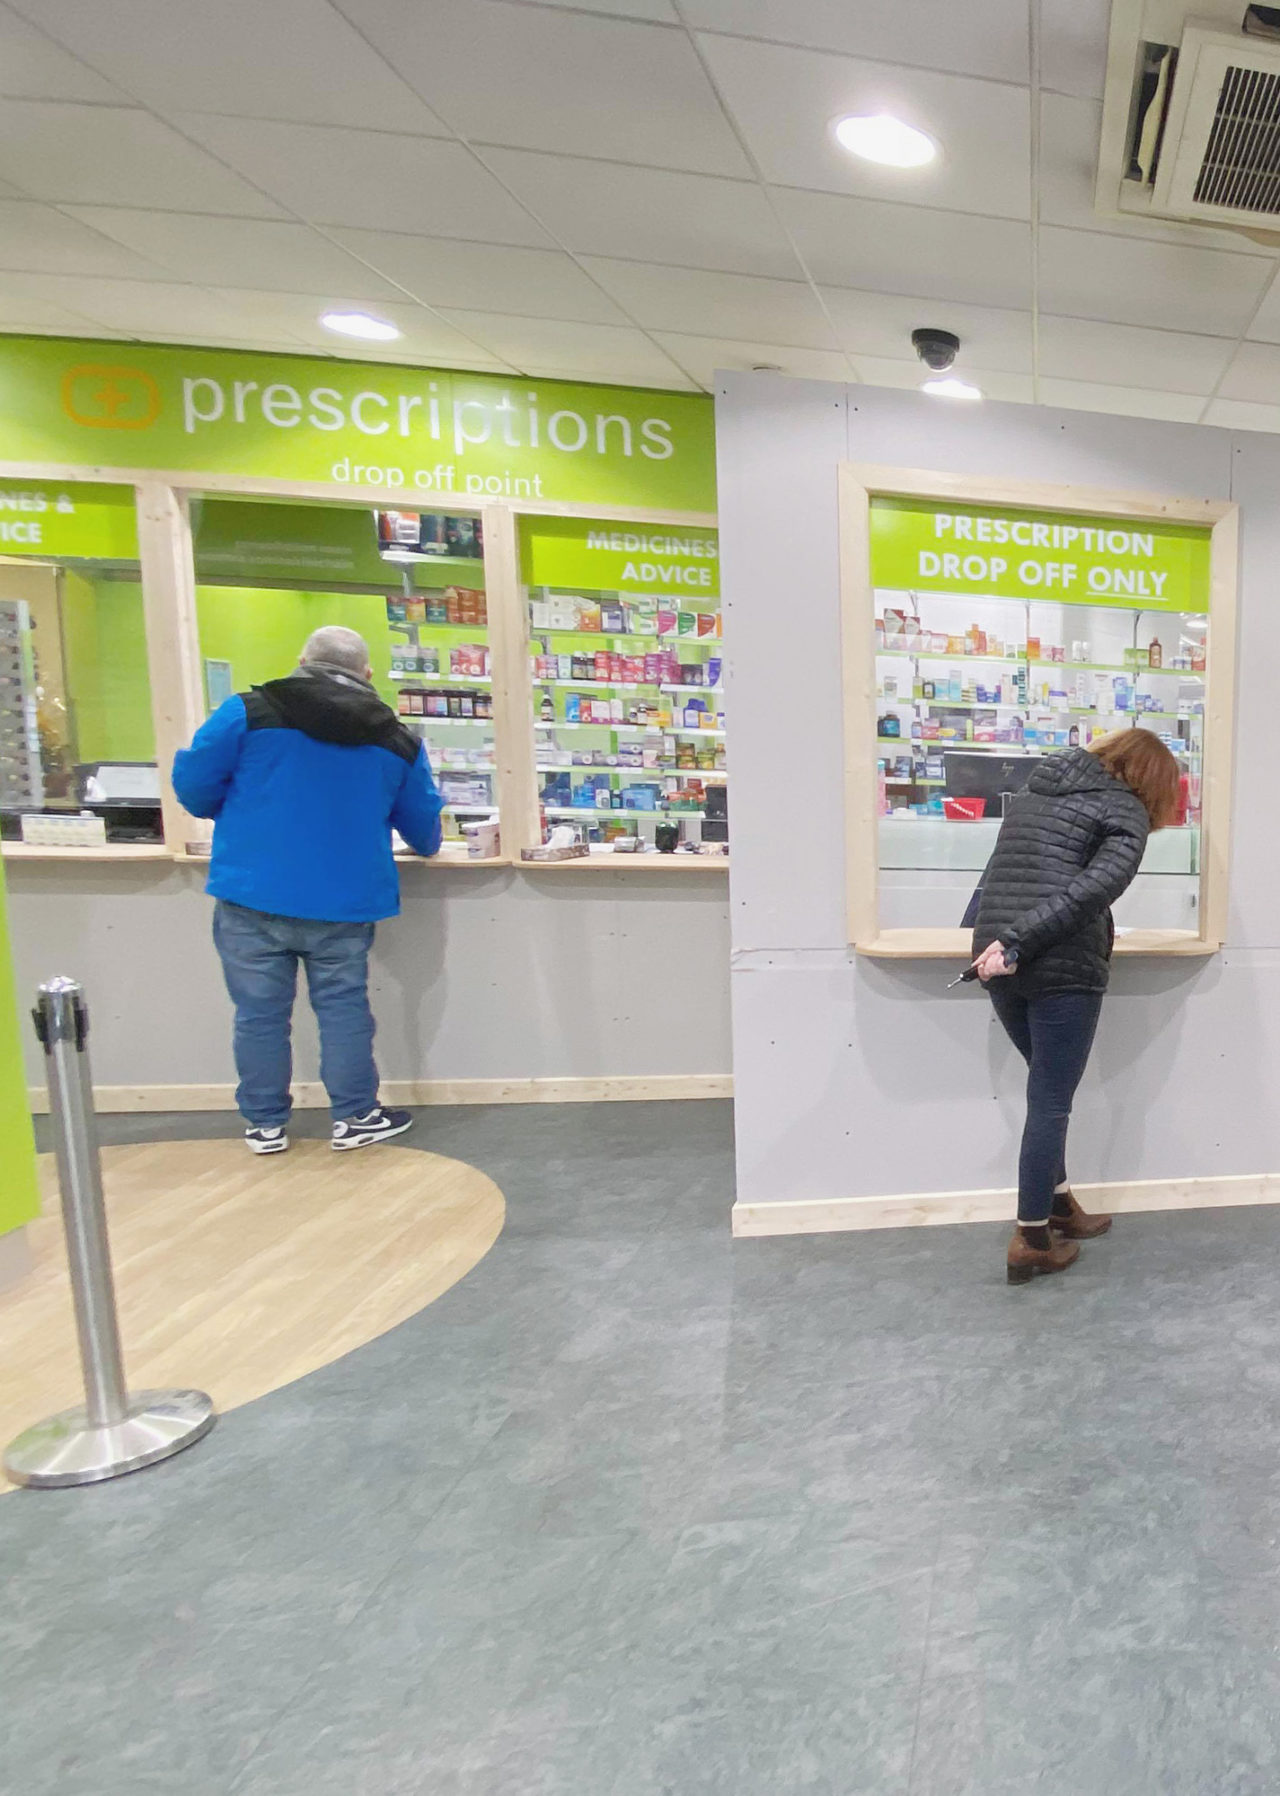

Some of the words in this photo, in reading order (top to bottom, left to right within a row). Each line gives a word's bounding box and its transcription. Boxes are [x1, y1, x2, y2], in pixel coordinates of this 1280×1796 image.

[183, 377, 674, 460] prescriptions
[331, 457, 404, 489] drop
[414, 463, 455, 490] off
[466, 471, 544, 498] point
[586, 531, 717, 558] MEDICINES
[934, 513, 1154, 557] PRESCRIPTION
[621, 561, 712, 586] ADVICE
[919, 551, 1008, 582] DROP
[1018, 560, 1077, 588] OFF
[1087, 566, 1168, 596] ONLY
